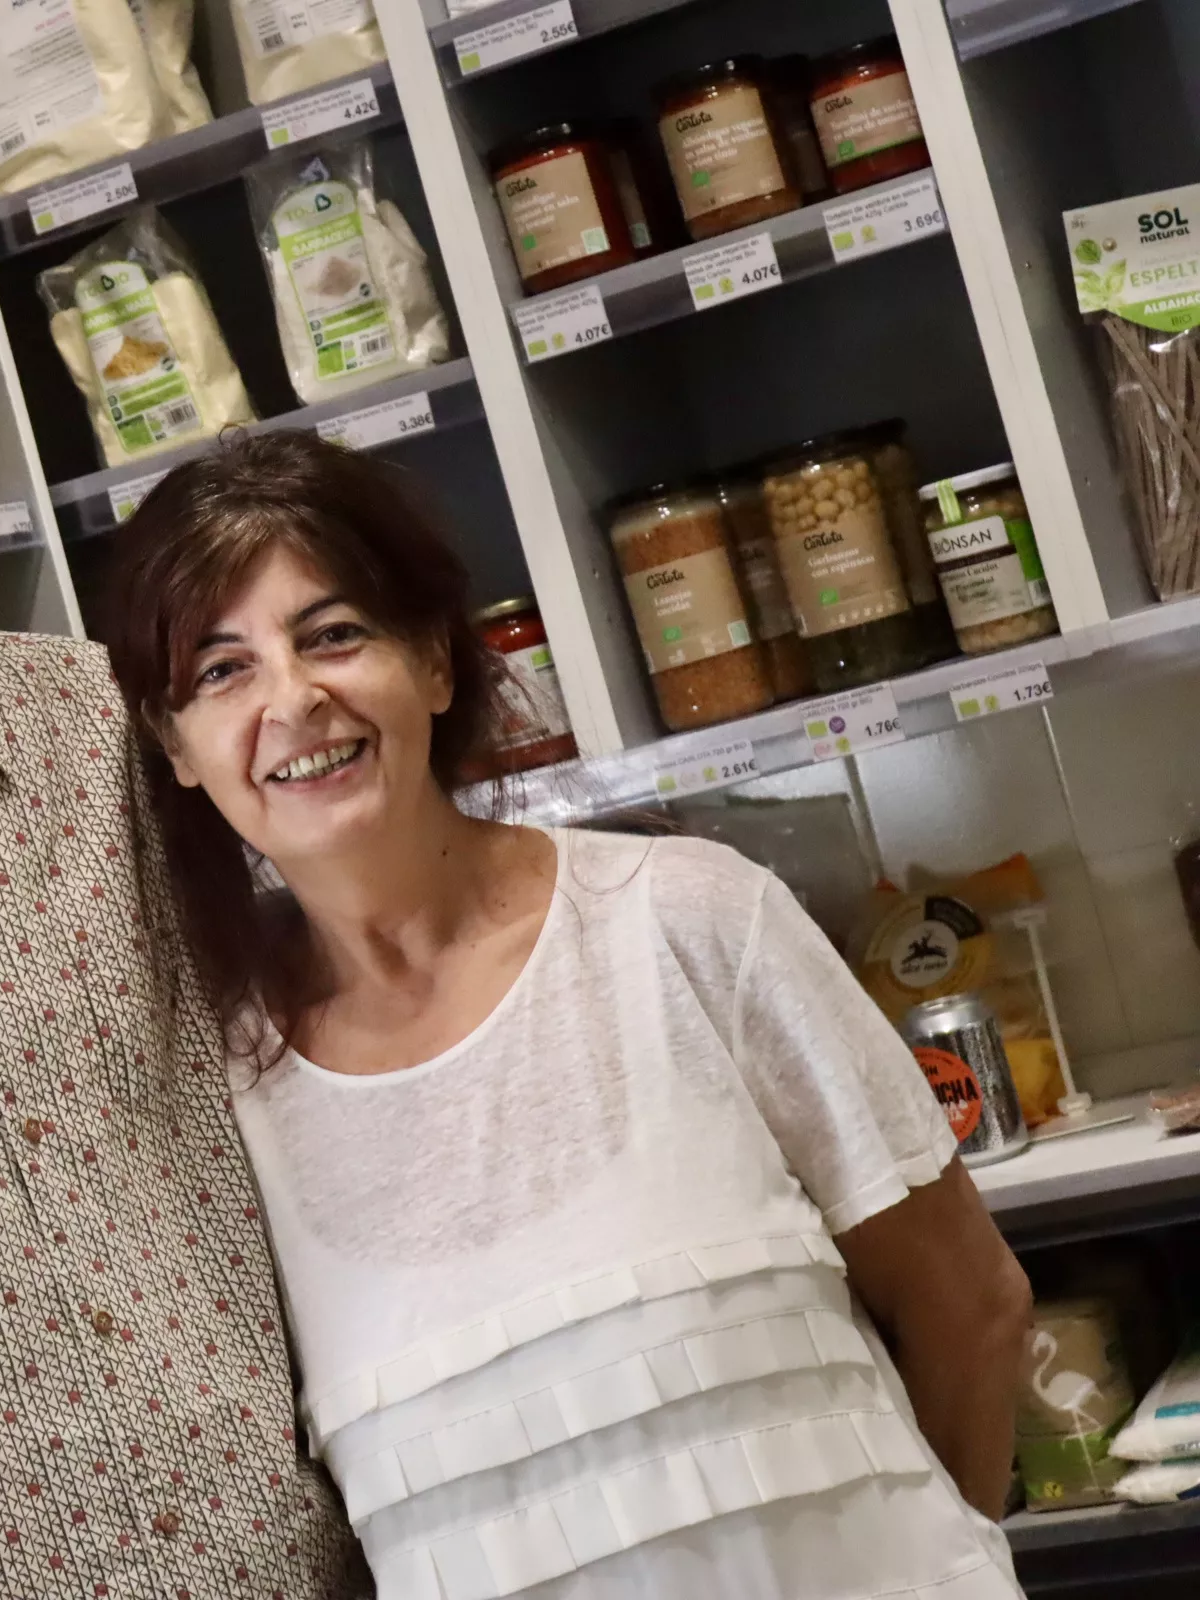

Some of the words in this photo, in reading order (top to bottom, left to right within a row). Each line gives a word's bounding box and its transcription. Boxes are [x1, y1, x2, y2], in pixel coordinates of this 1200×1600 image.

[540, 20, 576, 43] 2.55€
[343, 99, 377, 119] 4.42€
[104, 182, 136, 203] 2.50€
[903, 209, 942, 232] 3.69€
[1137, 206, 1189, 234] SOL
[1140, 226, 1191, 244] natural
[741, 263, 778, 284] 4.07€
[575, 324, 609, 343] 4.07€
[398, 412, 433, 432] 3.38€
[803, 530, 845, 552] Carlota
[807, 547, 860, 568] Garbanzos
[811, 567, 829, 579] con
[830, 555, 875, 574] espinacas
[646, 568, 685, 590] Carlota
[1013, 680, 1052, 702] 1.73€
[864, 717, 902, 737] 1.76€
[678, 751, 711, 765] CARLOTA
[721, 758, 758, 779] 2.61€
